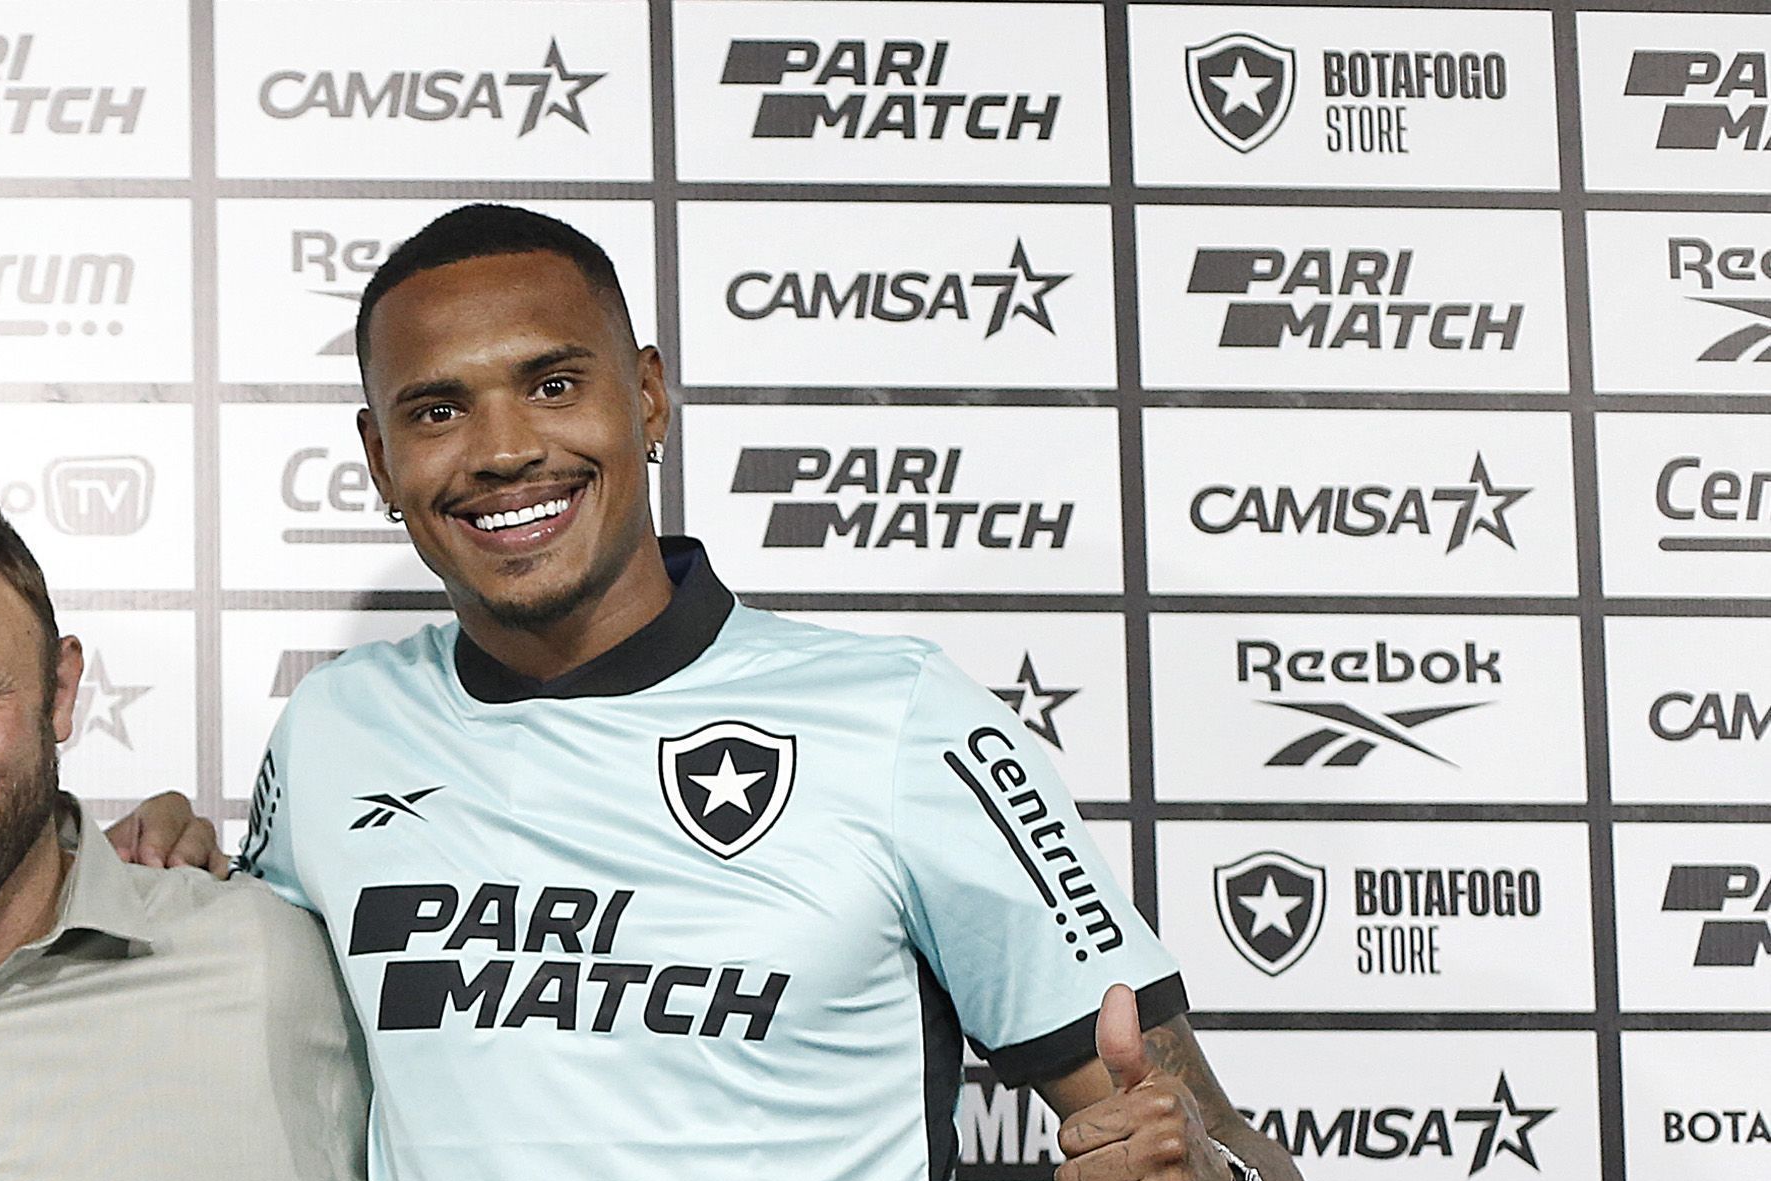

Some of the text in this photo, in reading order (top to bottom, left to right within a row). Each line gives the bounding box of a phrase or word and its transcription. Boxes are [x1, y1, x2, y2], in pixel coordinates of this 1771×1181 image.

[767, 39, 950, 86] PARI
[1323, 50, 1507, 100] BOTAFOGO
[1671, 51, 1771, 98] PA
[802, 92, 1061, 140] MATCH
[1326, 104, 1409, 153] STORE
[1234, 247, 1413, 296] PARI
[1266, 302, 1525, 350] MATCH
[778, 447, 962, 494] PARI
[69, 481, 128, 515] TV
[813, 501, 1075, 549] MATCH
[1237, 639, 1502, 692] Reebok
[968, 725, 1127, 956] Centrum
[1354, 868, 1541, 917] BOTAFOGO
[393, 883, 635, 956] PARI
[1357, 925, 1441, 975] STORE
[425, 961, 791, 1042] MATCH
[1231, 1106, 1559, 1179] AMISA7
